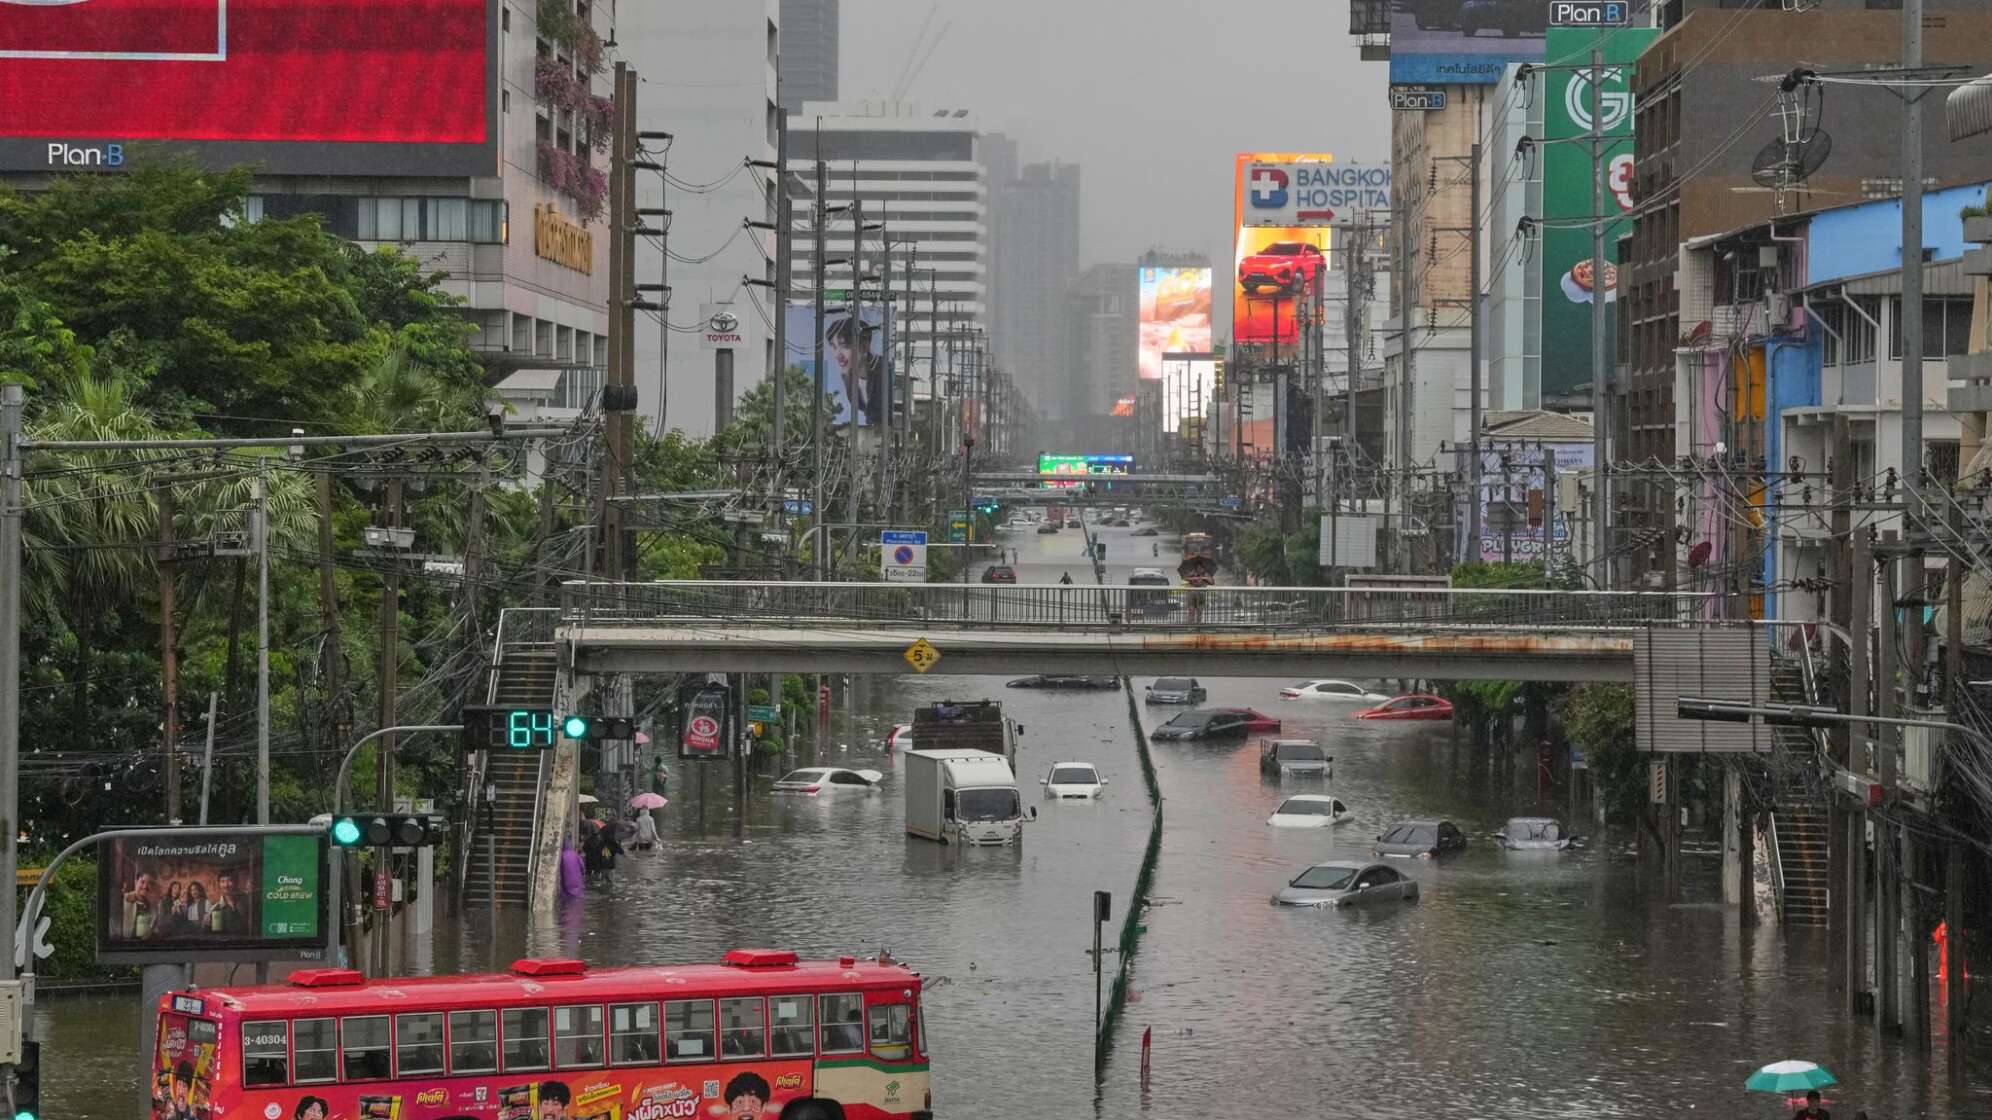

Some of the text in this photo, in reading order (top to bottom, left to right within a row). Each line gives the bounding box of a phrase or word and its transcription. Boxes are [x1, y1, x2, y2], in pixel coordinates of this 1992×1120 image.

[1558, 4, 1600, 22] Plan
[48, 143, 101, 165] Plan
[1296, 189, 1389, 208] HOSPITA
[707, 334, 741, 342] TOYOTA
[913, 649, 923, 662] 5
[511, 711, 552, 747] 64
[277, 875, 303, 885] Chang
[244, 1035, 287, 1046] 3-40304
